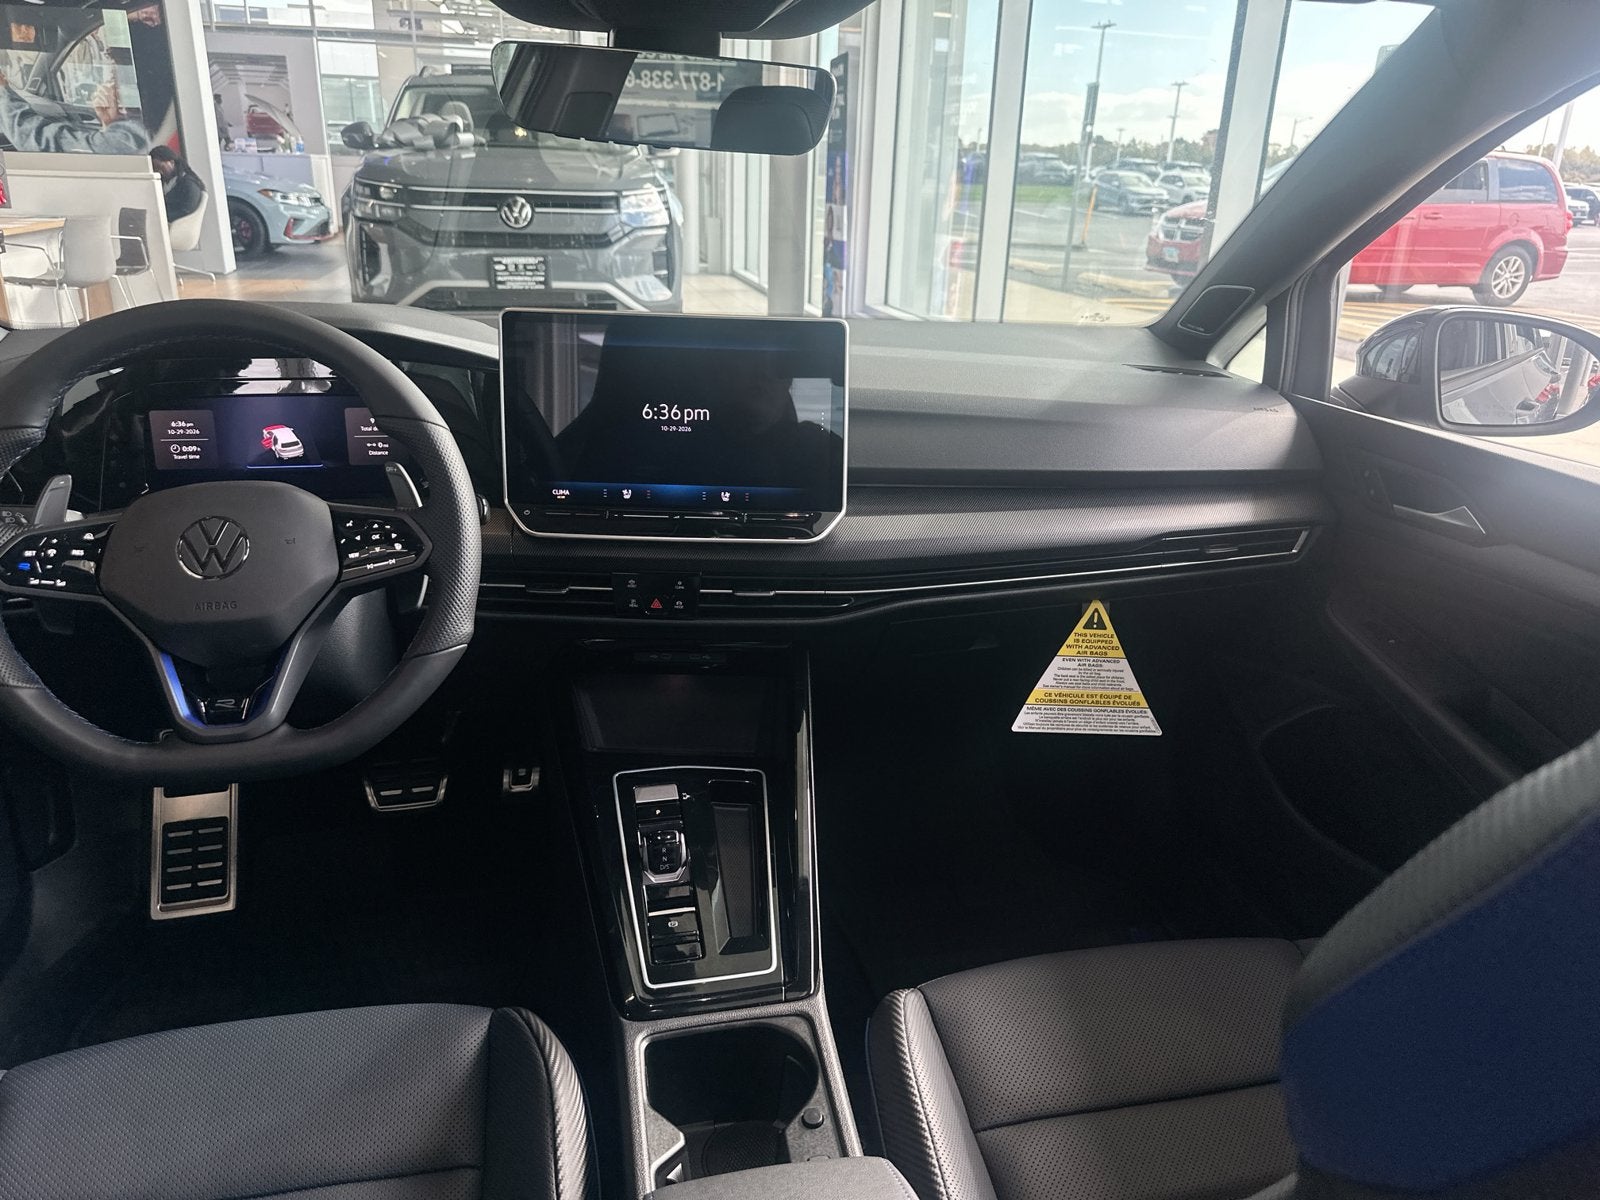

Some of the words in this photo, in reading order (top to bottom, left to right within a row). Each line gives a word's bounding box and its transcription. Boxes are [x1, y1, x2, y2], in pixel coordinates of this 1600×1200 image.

[194, 601, 238, 611] AIRBAG
[1054, 691, 1085, 699] VÉHICULE
[1112, 699, 1141, 707] ÉVOLUÉS
